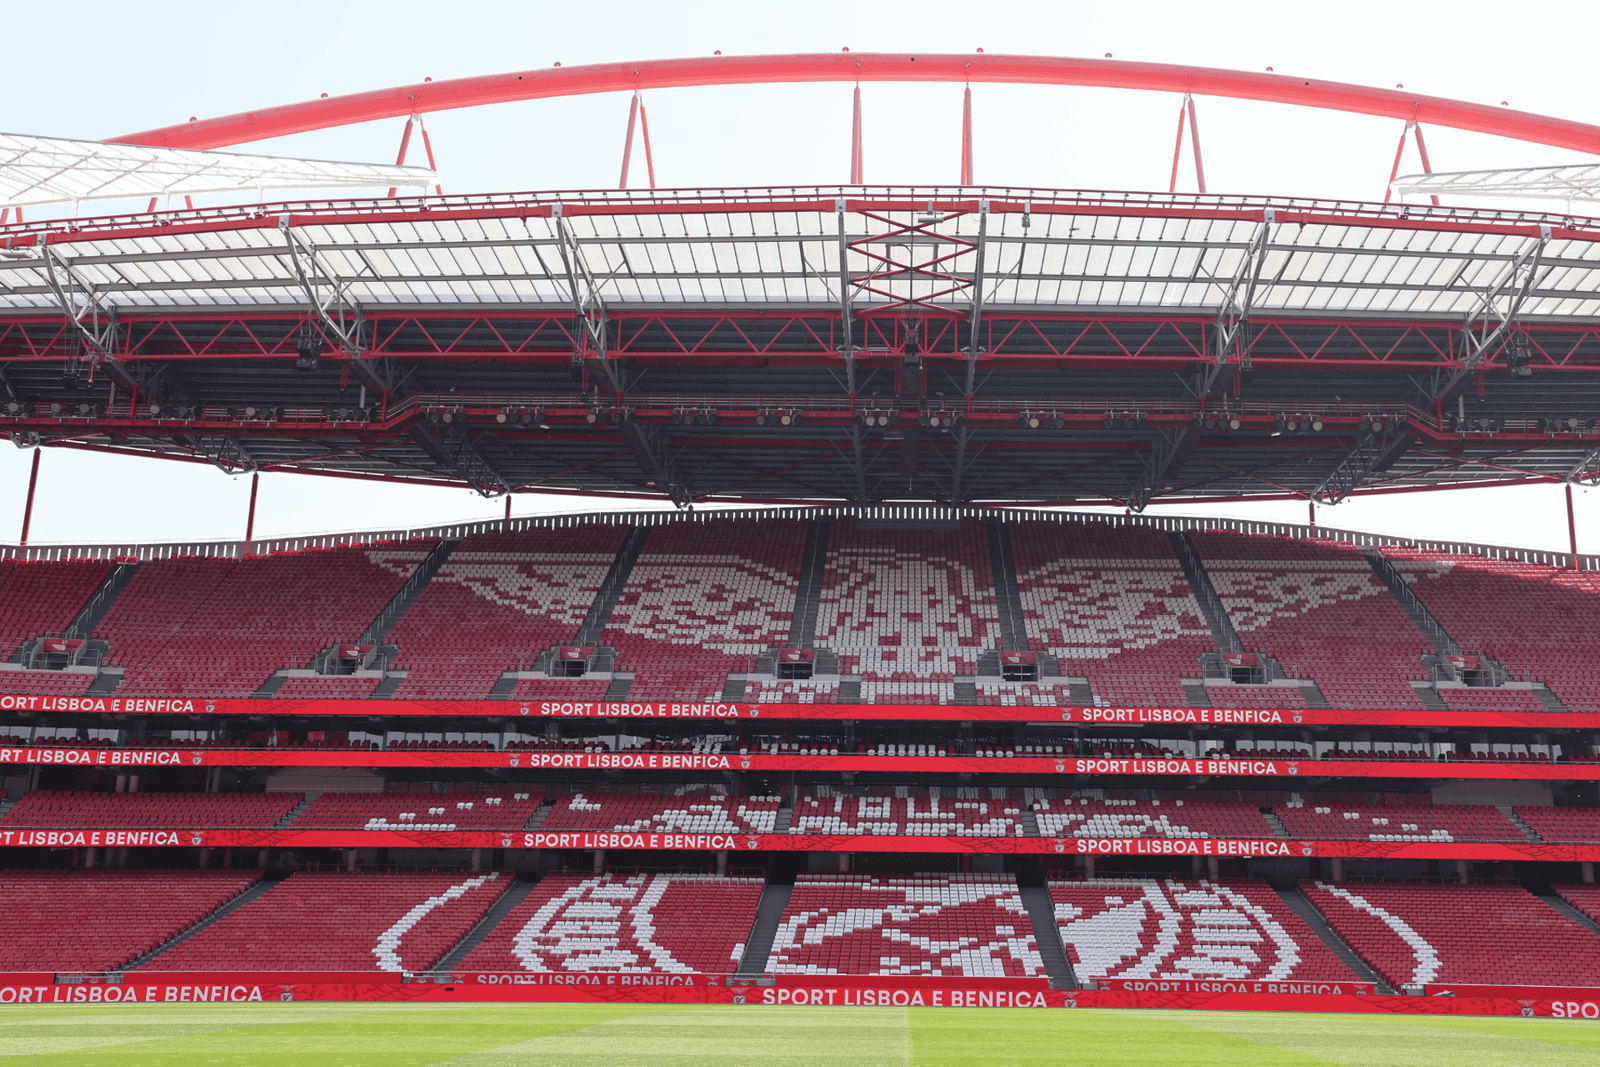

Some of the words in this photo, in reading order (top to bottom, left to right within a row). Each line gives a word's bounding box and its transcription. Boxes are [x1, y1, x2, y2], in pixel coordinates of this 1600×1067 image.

[1, 696, 38, 709] ORT
[43, 697, 106, 711] LISBOA
[112, 700, 121, 711] E
[125, 700, 194, 712] BENFICA
[541, 702, 593, 715] SPORT
[598, 703, 653, 716] LISBOA
[659, 704, 667, 716] E
[672, 704, 739, 717] BENFICA
[1083, 708, 1135, 721] SPORT
[1140, 709, 1196, 722] LISBOA
[1201, 710, 1209, 722] E
[1214, 710, 1282, 723] BENFICA
[0, 749, 23, 761] RT
[27, 750, 91, 763] LISBOA
[98, 751, 107, 763] E
[112, 752, 181, 764] BENFICA
[531, 754, 583, 767] SPORT
[588, 755, 644, 767] LISBOA
[649, 756, 657, 767] E
[662, 756, 730, 768] BENFICA
[1077, 760, 1129, 772] SPORT
[1134, 761, 1191, 773] LISBOA
[1195, 761, 1203, 773] E
[1208, 762, 1277, 775] BENFICA
[0, 832, 14, 844] T
[19, 832, 85, 845] LISBOA
[91, 832, 100, 844] E
[106, 832, 180, 845] BENFICA
[524, 834, 580, 847] SPORT
[585, 834, 645, 848] LISBOA
[650, 835, 659, 847] E
[664, 835, 736, 848] BENFICA
[1077, 839, 1133, 852] SPORT
[1138, 840, 1199, 854] LISBOA
[1204, 841, 1212, 854] E
[1217, 841, 1291, 855] BENFICA
[0, 986, 48, 1002] ORT
[54, 986, 138, 1002] LISBOA
[146, 986, 157, 1002] E
[165, 986, 263, 1002] BENFICA
[763, 988, 838, 1005] SPORT
[844, 988, 926, 1006] LISBOA
[933, 989, 943, 1006] E
[951, 989, 1047, 1008] BENFICA
[1552, 1001, 1600, 1018] SPO
